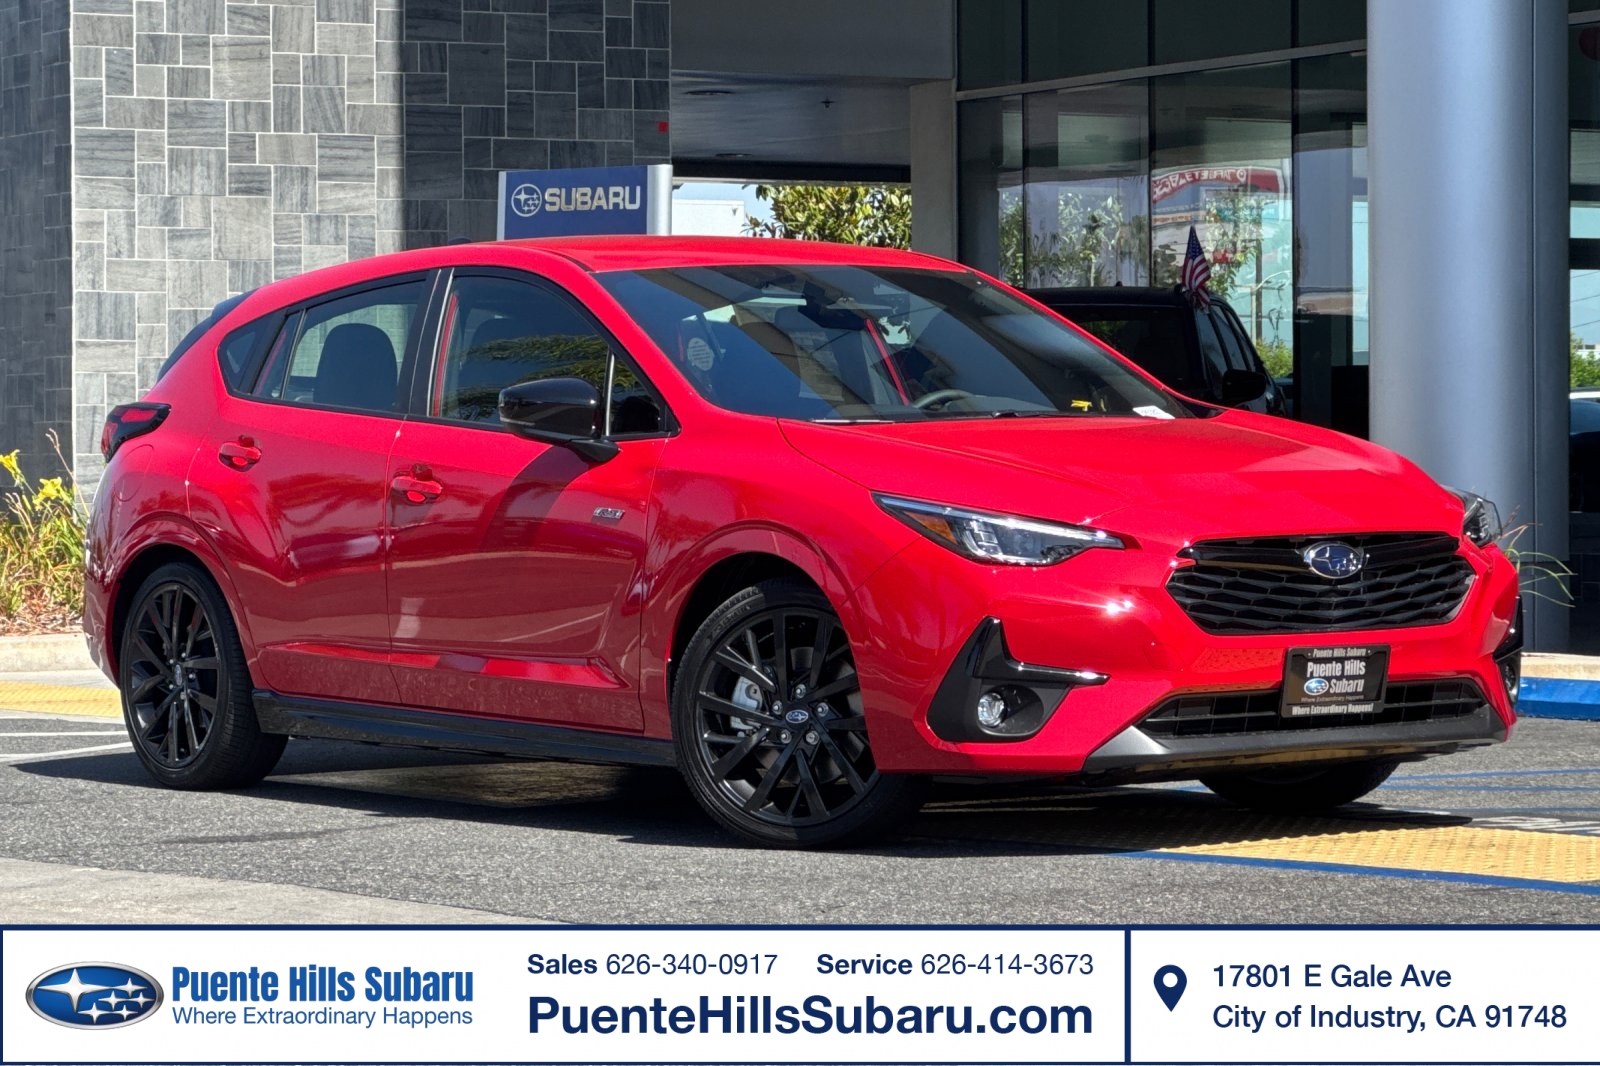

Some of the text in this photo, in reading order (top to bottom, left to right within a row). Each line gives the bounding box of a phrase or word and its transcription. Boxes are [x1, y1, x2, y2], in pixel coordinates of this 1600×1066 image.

[544, 185, 641, 212] SUBARU
[1306, 659, 1366, 678] Puente Hills
[1329, 679, 1364, 694] Subaru
[1292, 706, 1310, 716] Where
[1311, 704, 1347, 714] Extraordinary
